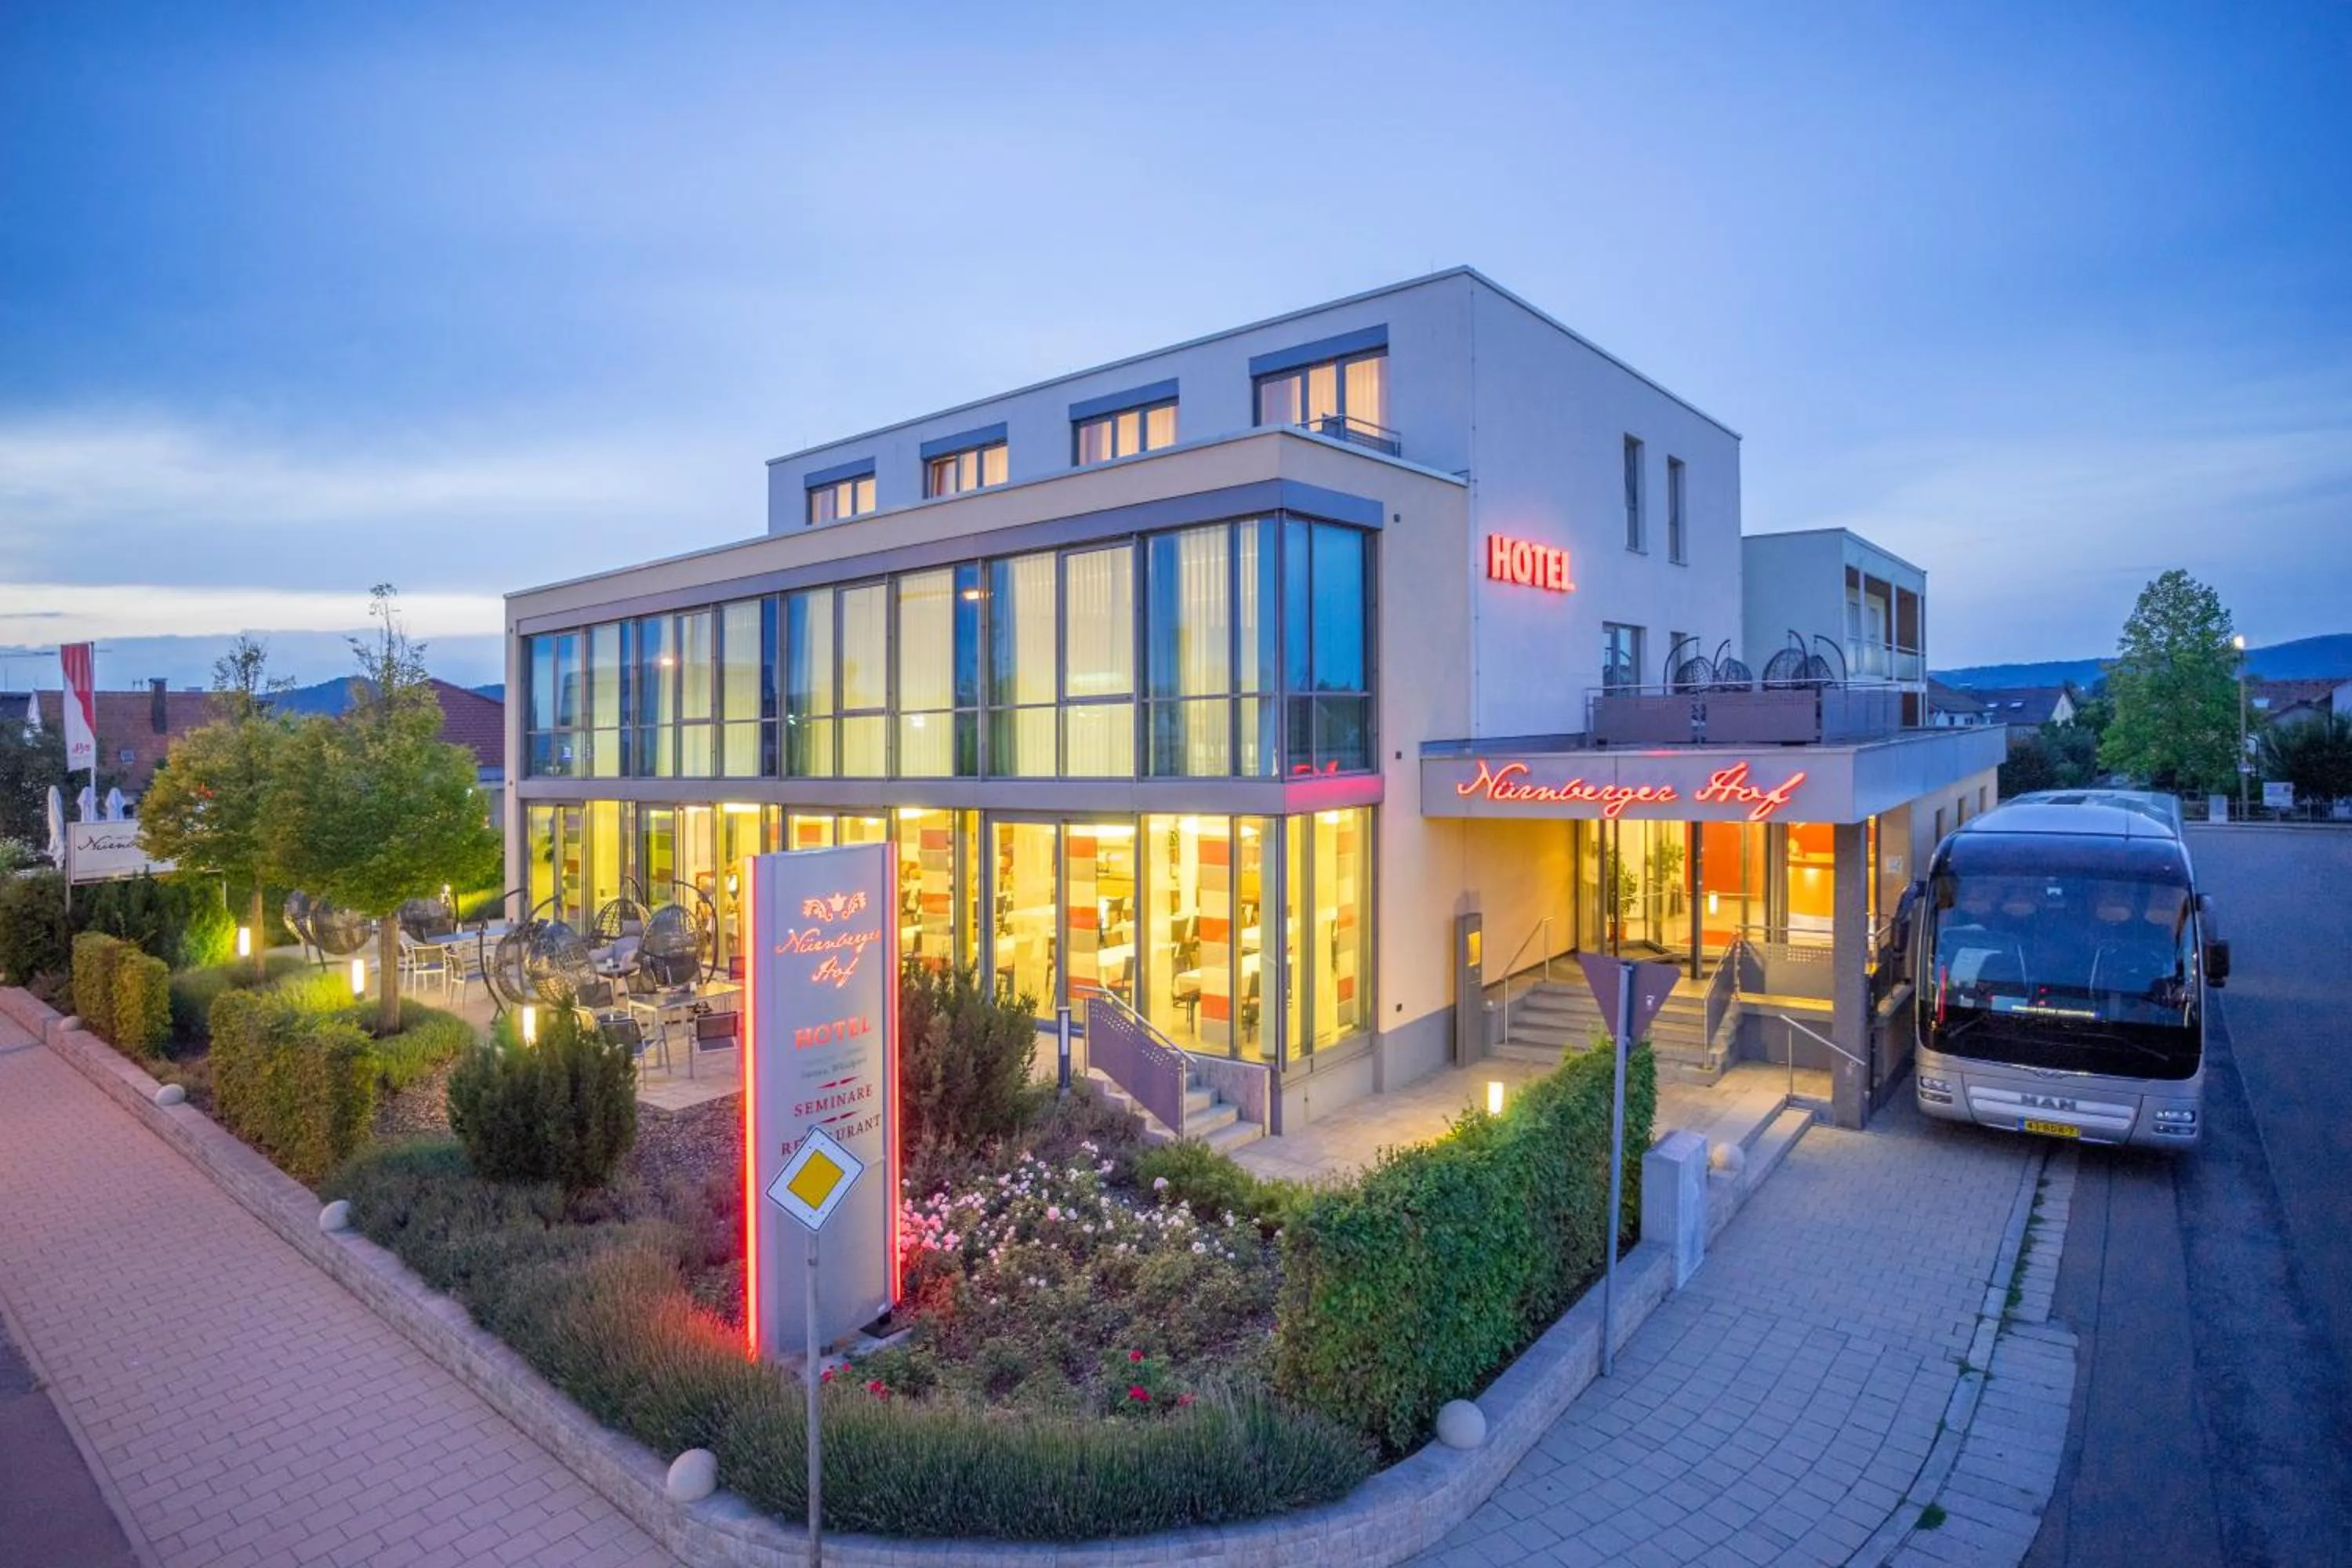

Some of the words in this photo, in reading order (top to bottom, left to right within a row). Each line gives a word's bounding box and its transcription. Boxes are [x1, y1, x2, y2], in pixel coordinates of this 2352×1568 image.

[1487, 533, 1576, 593] HOTEL
[1457, 758, 1679, 818] Nürnberger
[1694, 760, 1806, 822] Hof
[775, 927, 882, 954] Nürnberger
[811, 955, 860, 989] Hof
[795, 1014, 871, 1051] HOTEL
[793, 1083, 873, 1117] SEMINARE
[2020, 1093, 2077, 1112] MAN
[781, 1113, 880, 1155] REURANT
